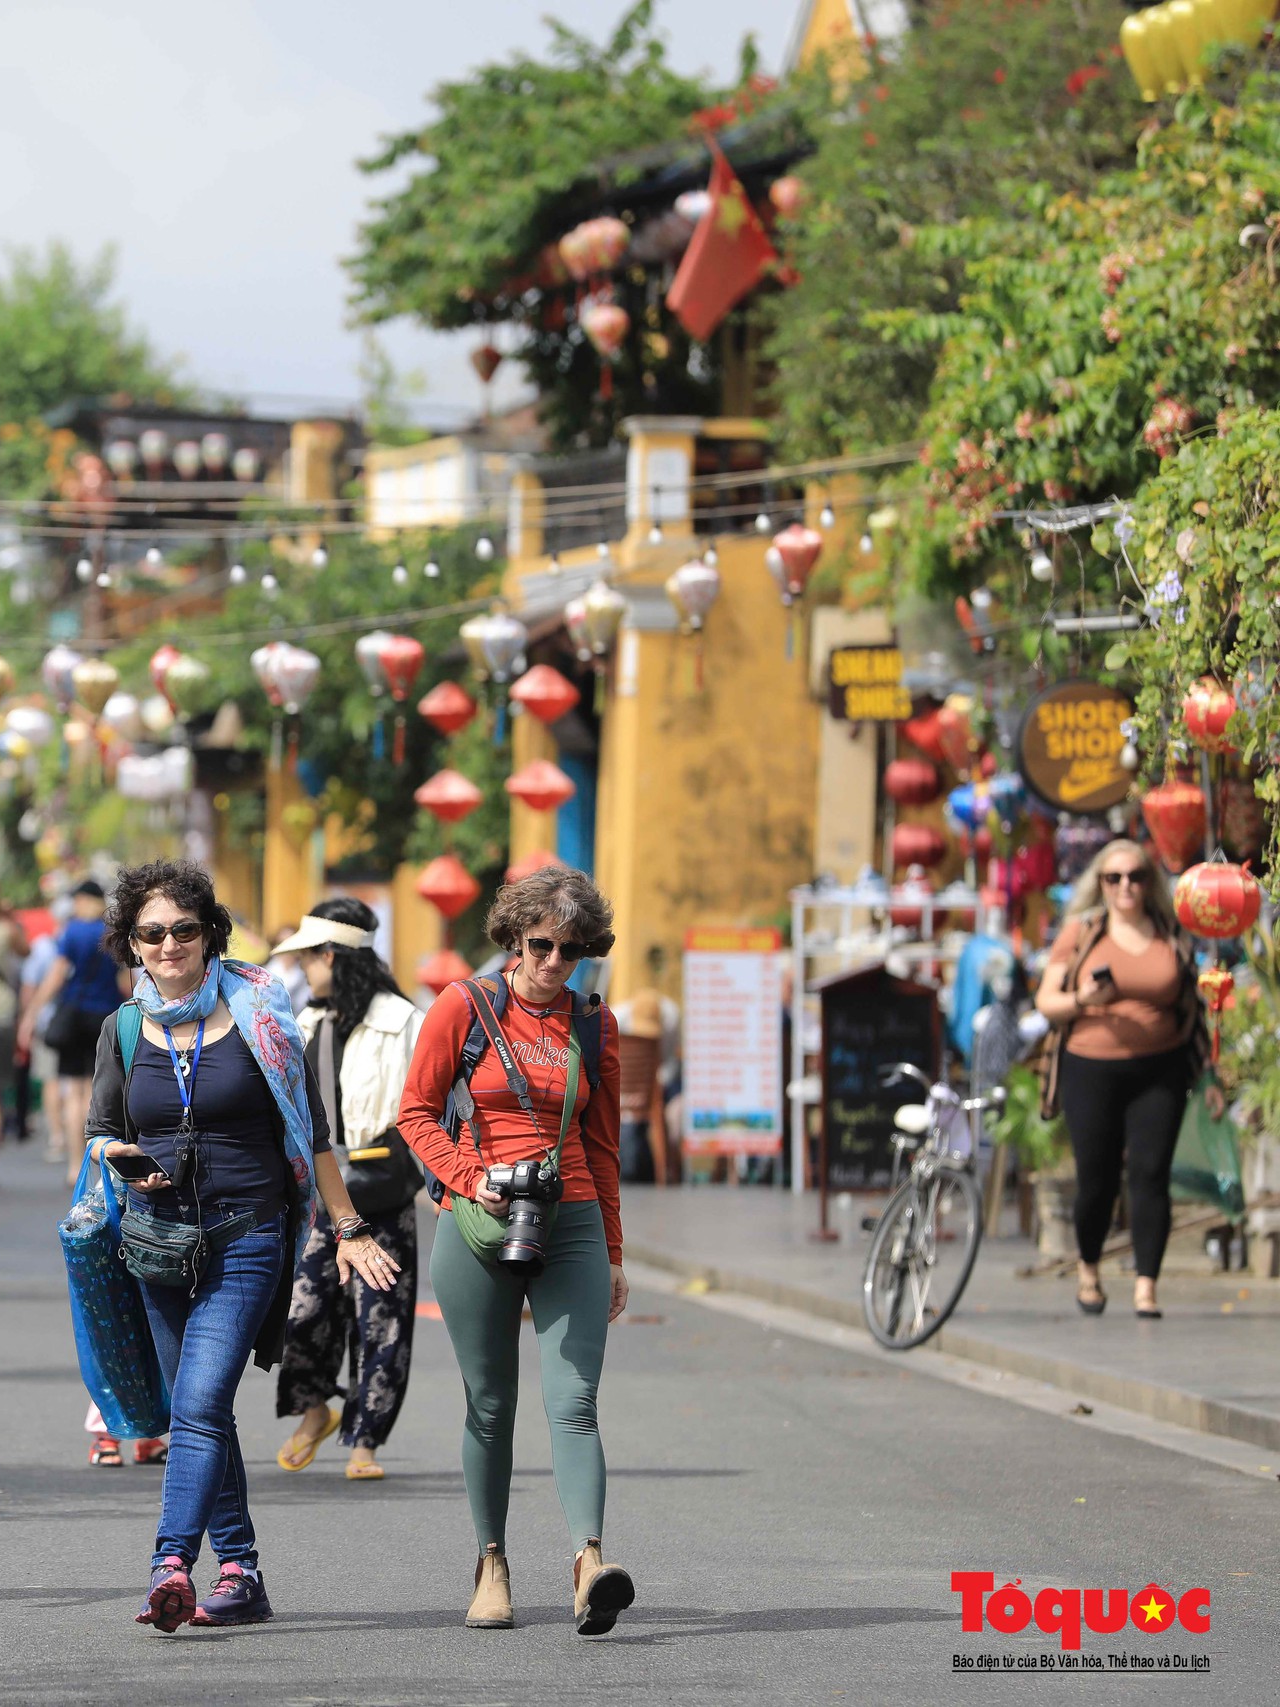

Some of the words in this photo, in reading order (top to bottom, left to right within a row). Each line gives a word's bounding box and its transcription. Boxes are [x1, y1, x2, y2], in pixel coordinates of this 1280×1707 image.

[1037, 699, 1131, 732] SHOES
[1046, 729, 1128, 760] SHOP
[494, 1036, 513, 1070] Canon
[511, 1037, 570, 1069] nike
